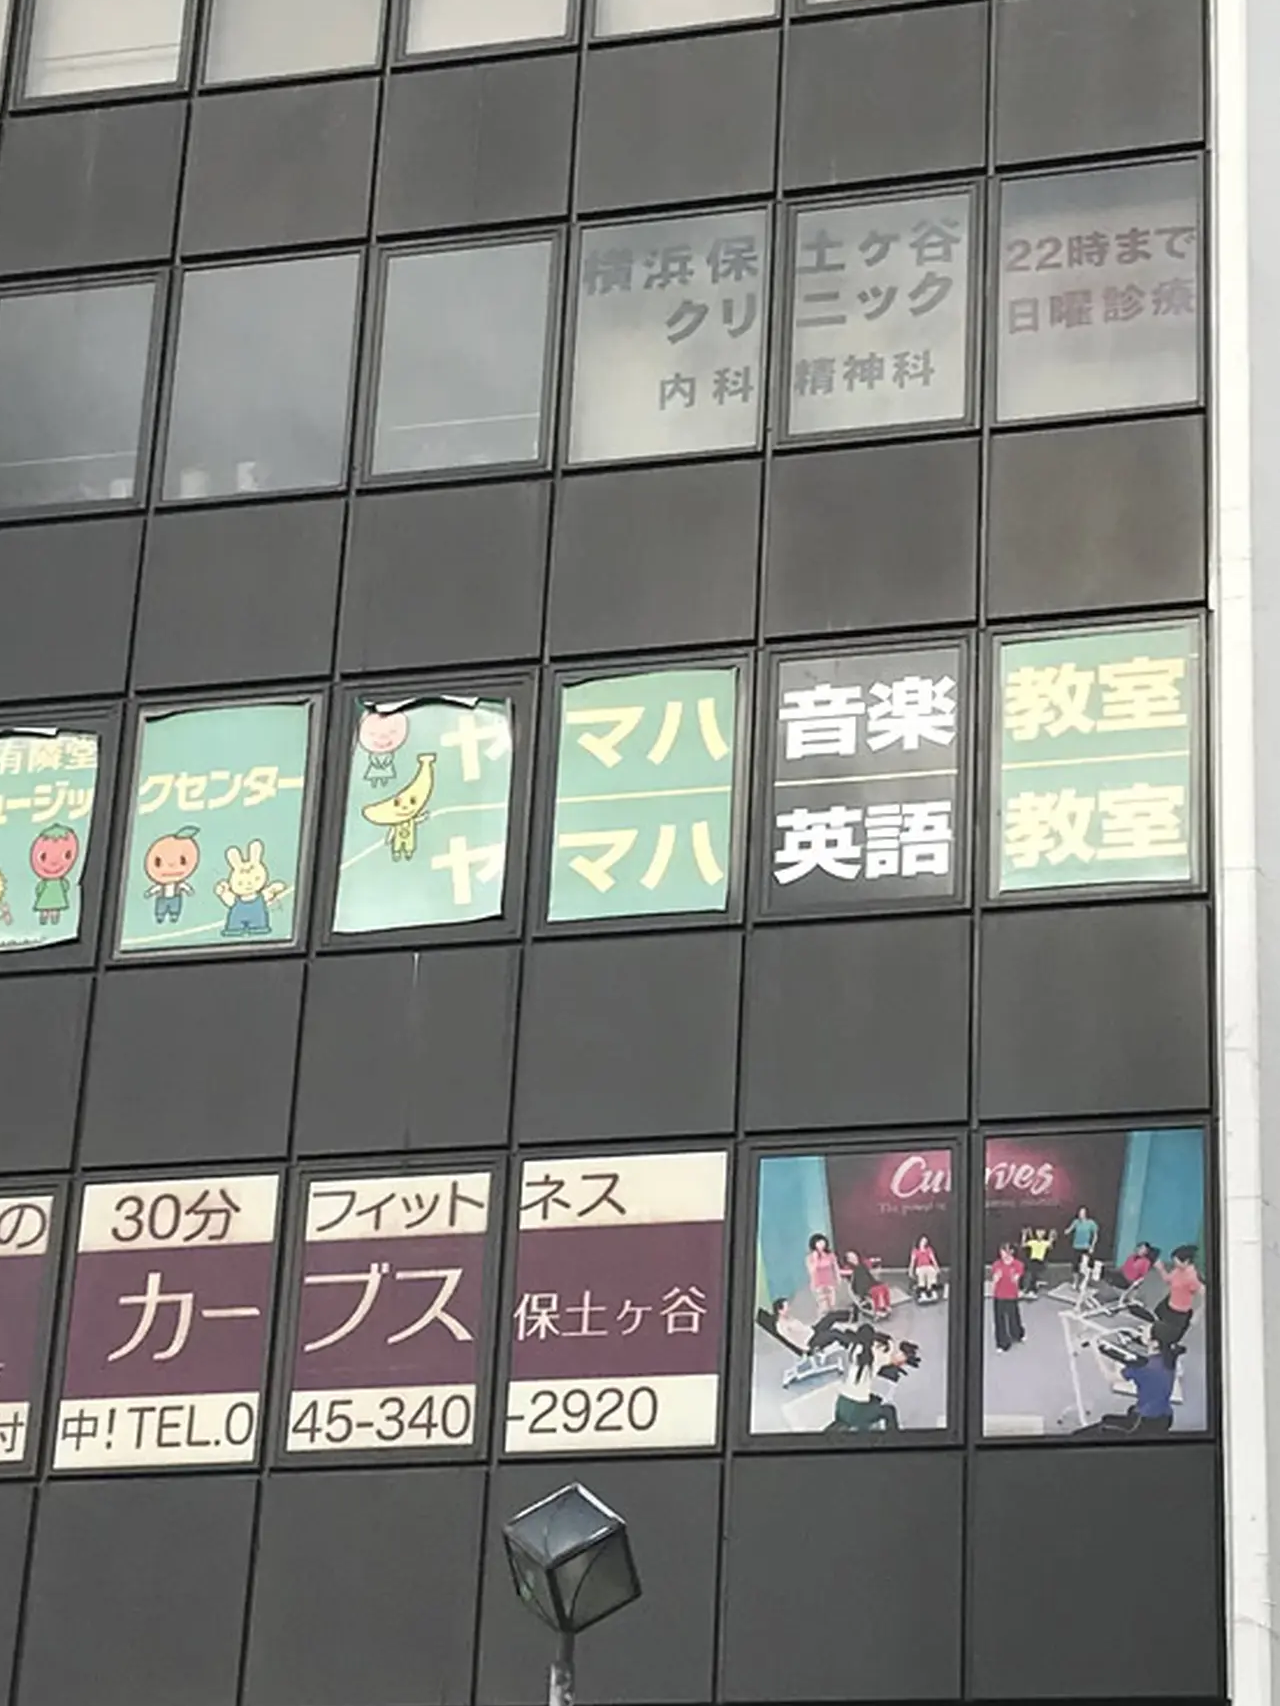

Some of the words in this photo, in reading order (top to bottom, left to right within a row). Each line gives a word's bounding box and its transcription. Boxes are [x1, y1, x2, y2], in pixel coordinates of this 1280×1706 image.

[1004, 224, 1197, 273] 22時まで
[1007, 277, 1196, 334] 日曜診療
